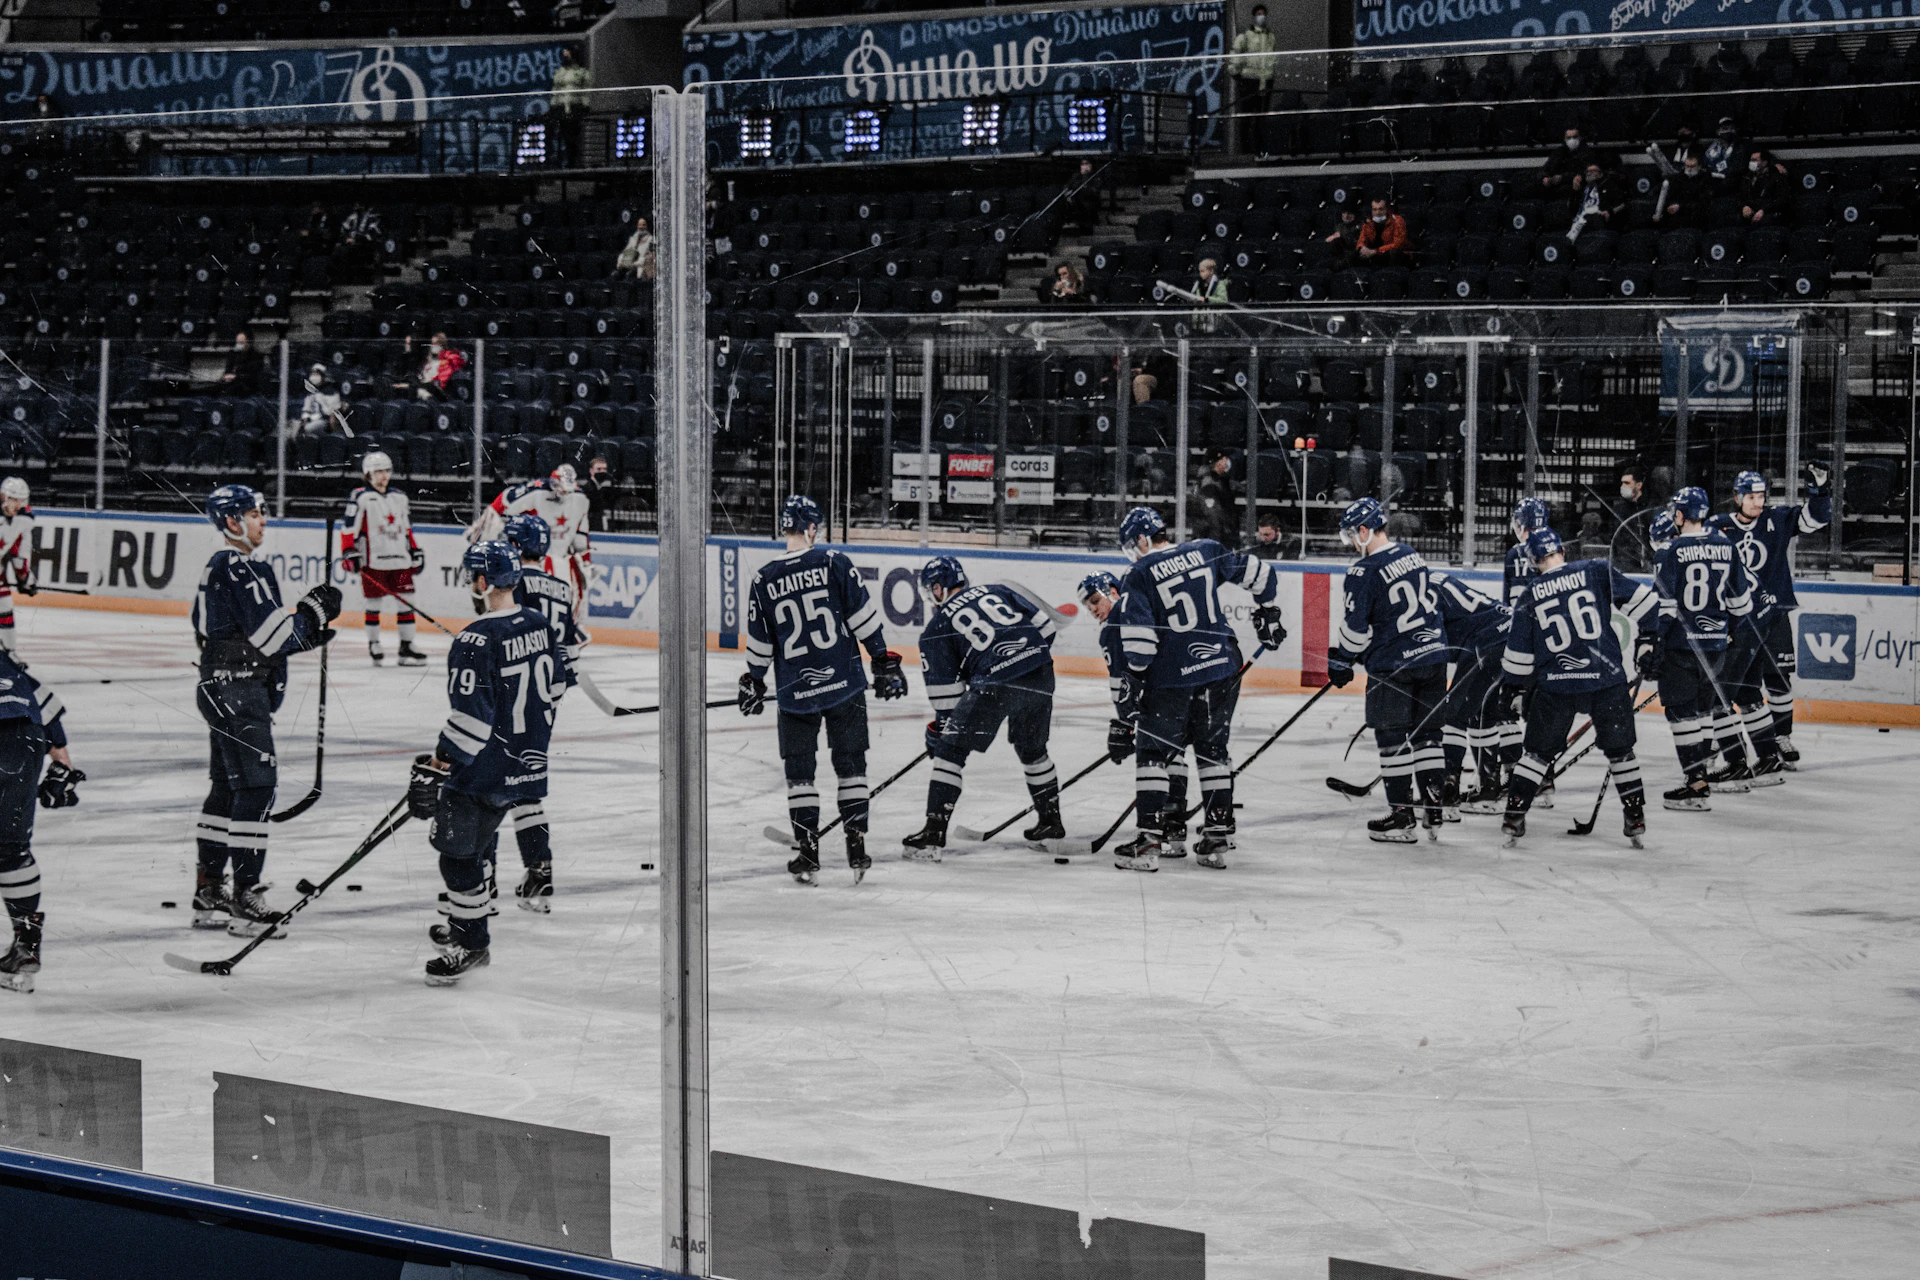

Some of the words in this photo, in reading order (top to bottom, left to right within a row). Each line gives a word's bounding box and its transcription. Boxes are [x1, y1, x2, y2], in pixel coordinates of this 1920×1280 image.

[949, 459, 993, 472] FONBET
[782, 516, 793, 528] 25
[1766, 518, 1776, 532] A
[1149, 550, 1205, 582] KRUGLOV
[589, 564, 648, 608] SAP
[766, 567, 829, 601] O.ZAITSEV
[1156, 567, 1218, 634] 57
[1532, 570, 1587, 602] IGUMNOV
[1683, 562, 1731, 612] 87
[941, 585, 990, 618] ZAITSEV
[539, 597, 567, 643] 15
[774, 589, 838, 660] 25
[951, 594, 1023, 652] 86
[1534, 589, 1602, 654] 56
[502, 627, 549, 662] TARASOV
[449, 668, 476, 696] 79
